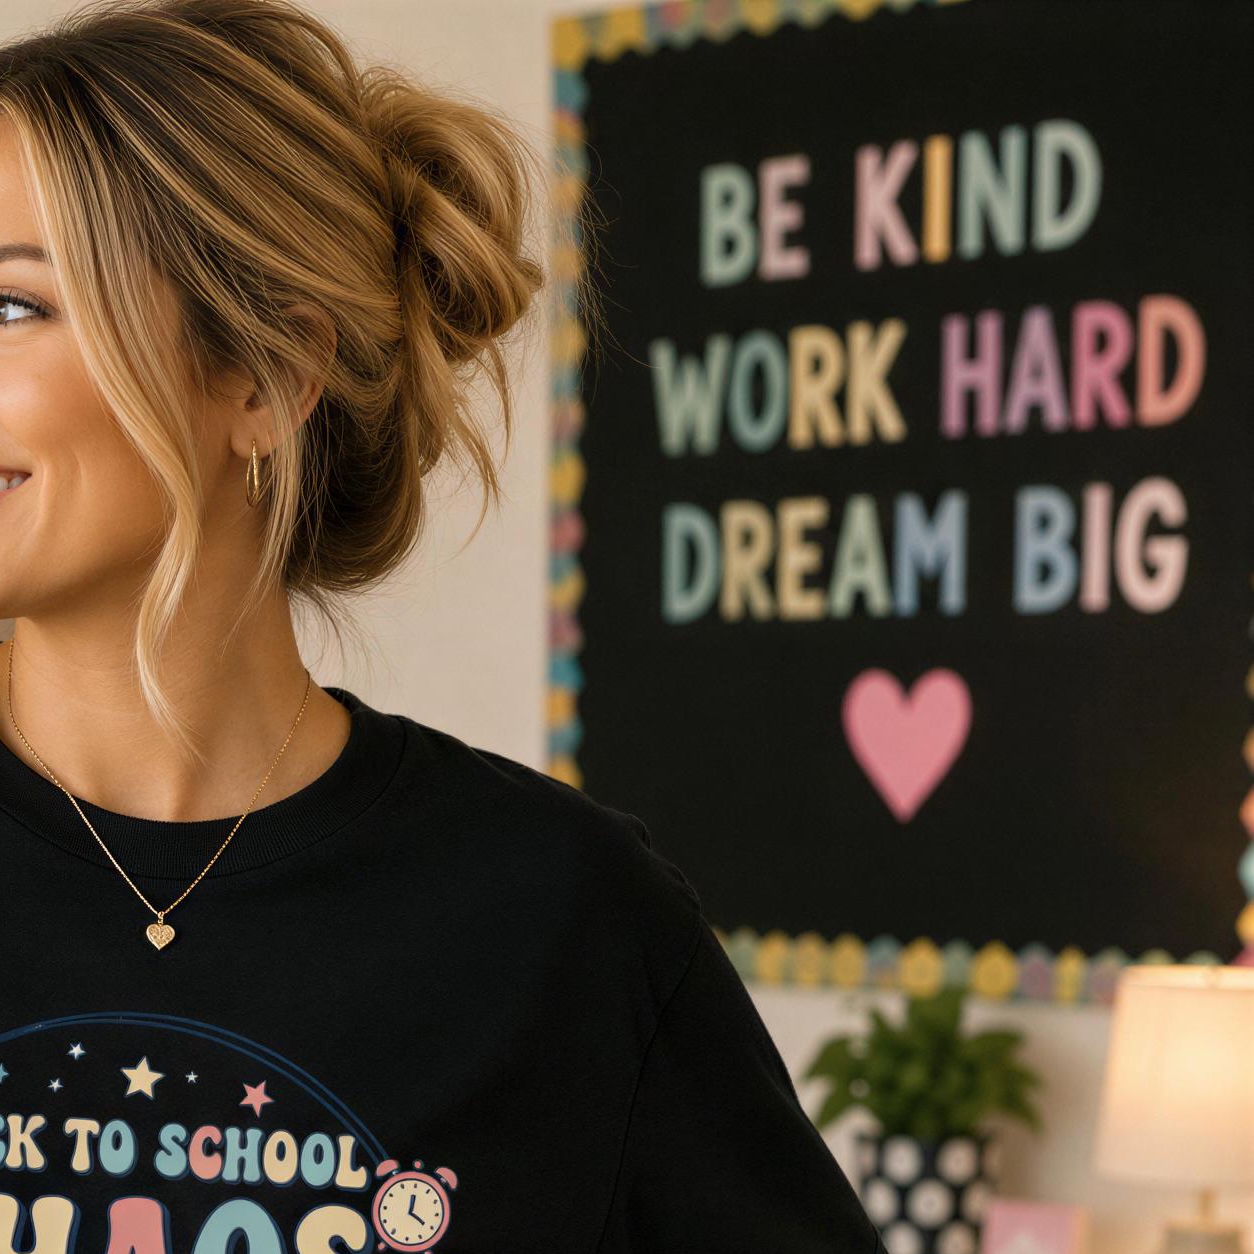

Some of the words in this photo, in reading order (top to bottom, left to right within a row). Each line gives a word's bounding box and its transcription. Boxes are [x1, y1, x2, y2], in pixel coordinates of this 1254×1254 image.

[698, 153, 811, 289] BE
[853, 117, 1104, 272] KIND
[649, 316, 908, 459] WORK
[940, 293, 1207, 438] HARD
[661, 489, 968, 625] DREAM
[1012, 475, 1190, 615] BIG
[64, 1117, 137, 1177] TO
[153, 1122, 373, 1191] SCHOOL
